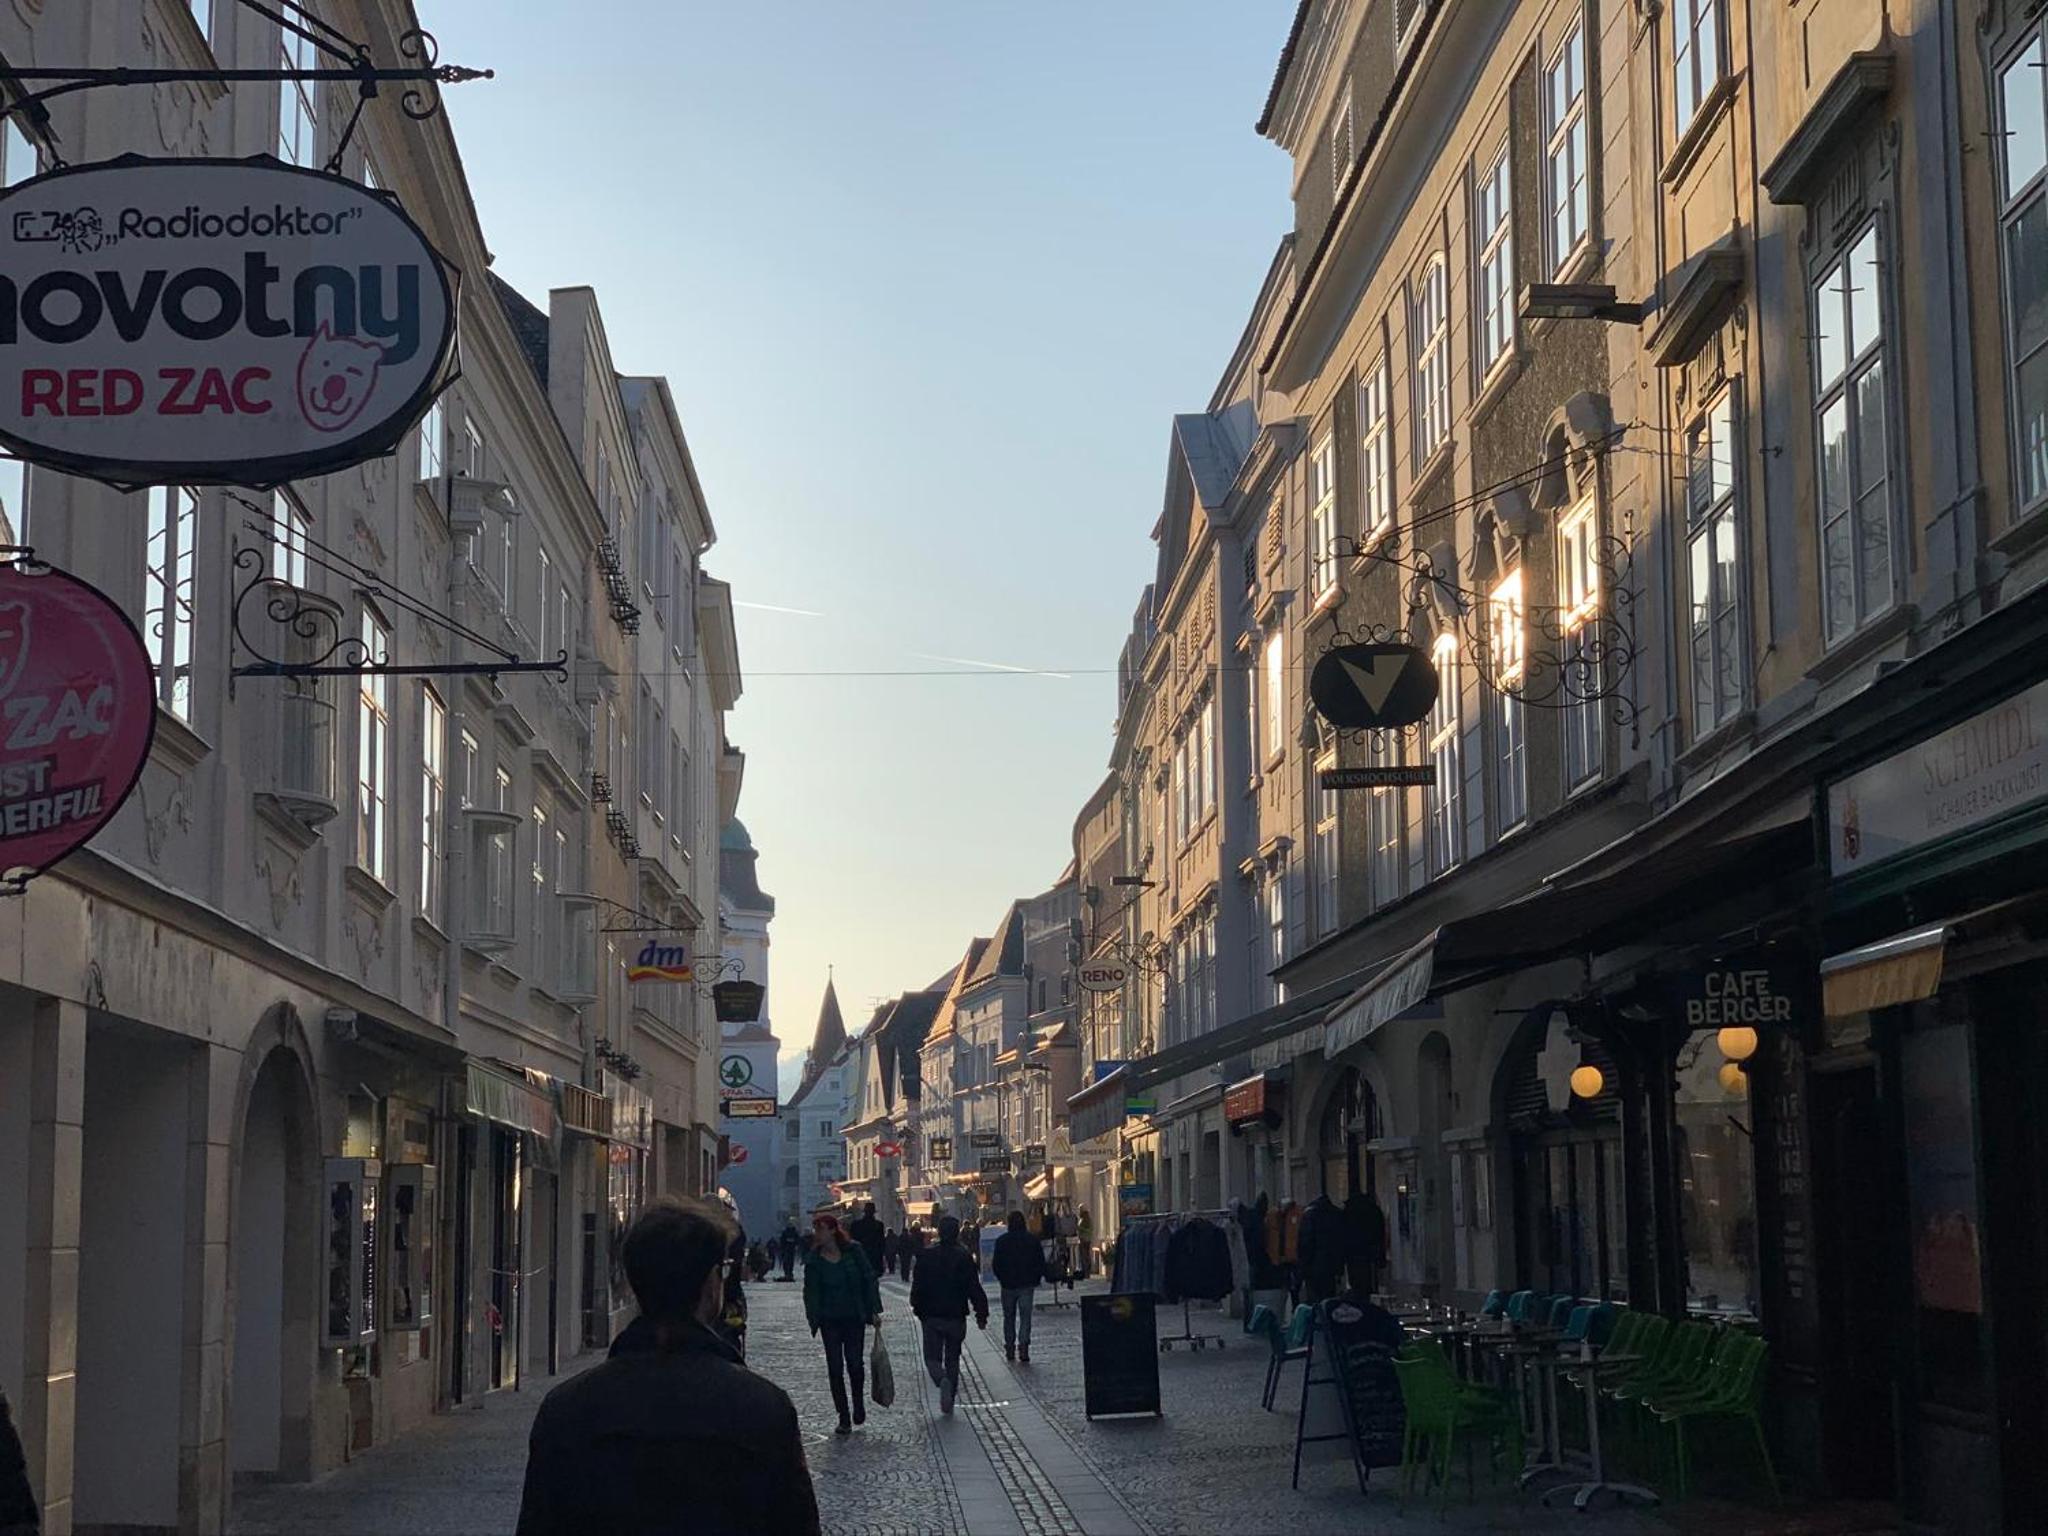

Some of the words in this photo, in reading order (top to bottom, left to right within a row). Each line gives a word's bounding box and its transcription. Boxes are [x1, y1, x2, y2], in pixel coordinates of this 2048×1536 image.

[22, 368, 143, 417] RED
[157, 367, 272, 416] ZAC
[4, 686, 113, 750] ZAC
[638, 939, 684, 967] dm
[1081, 969, 1124, 982] RENO
[1686, 995, 1792, 1025] BERGER
